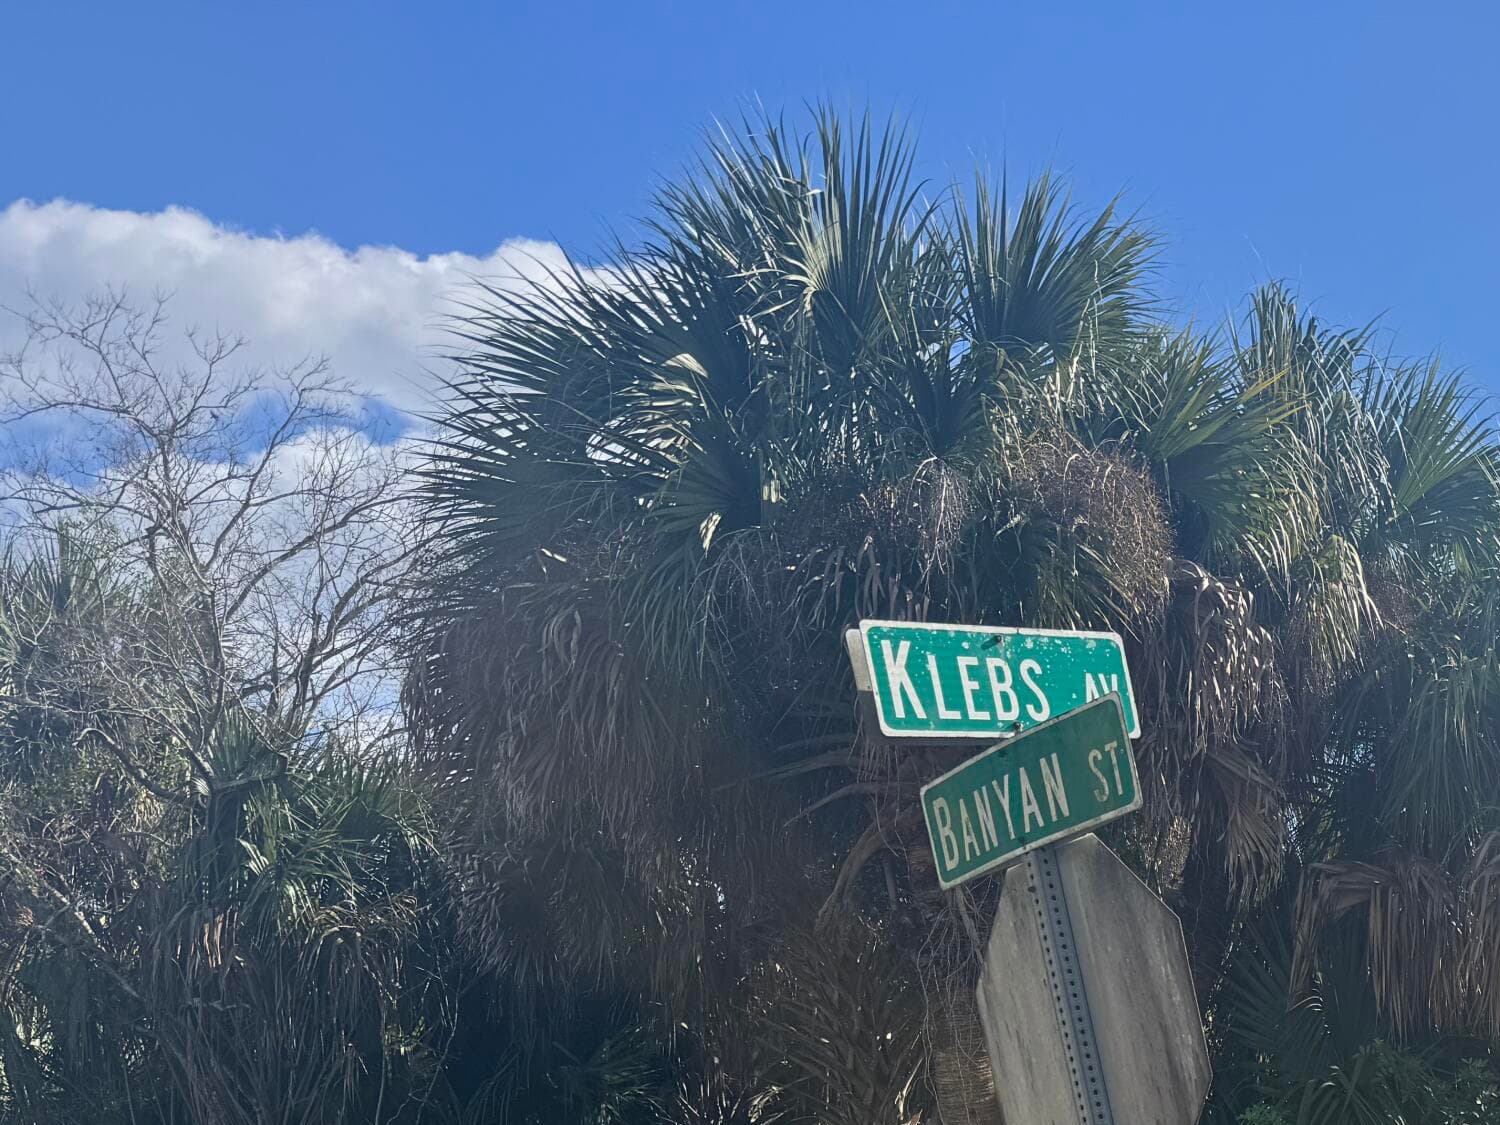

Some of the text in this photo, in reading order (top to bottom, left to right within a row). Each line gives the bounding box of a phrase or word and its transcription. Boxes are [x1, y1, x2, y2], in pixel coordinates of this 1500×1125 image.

[880, 639, 1050, 722] KLEBS
[932, 741, 1124, 872] BANYAN ST
